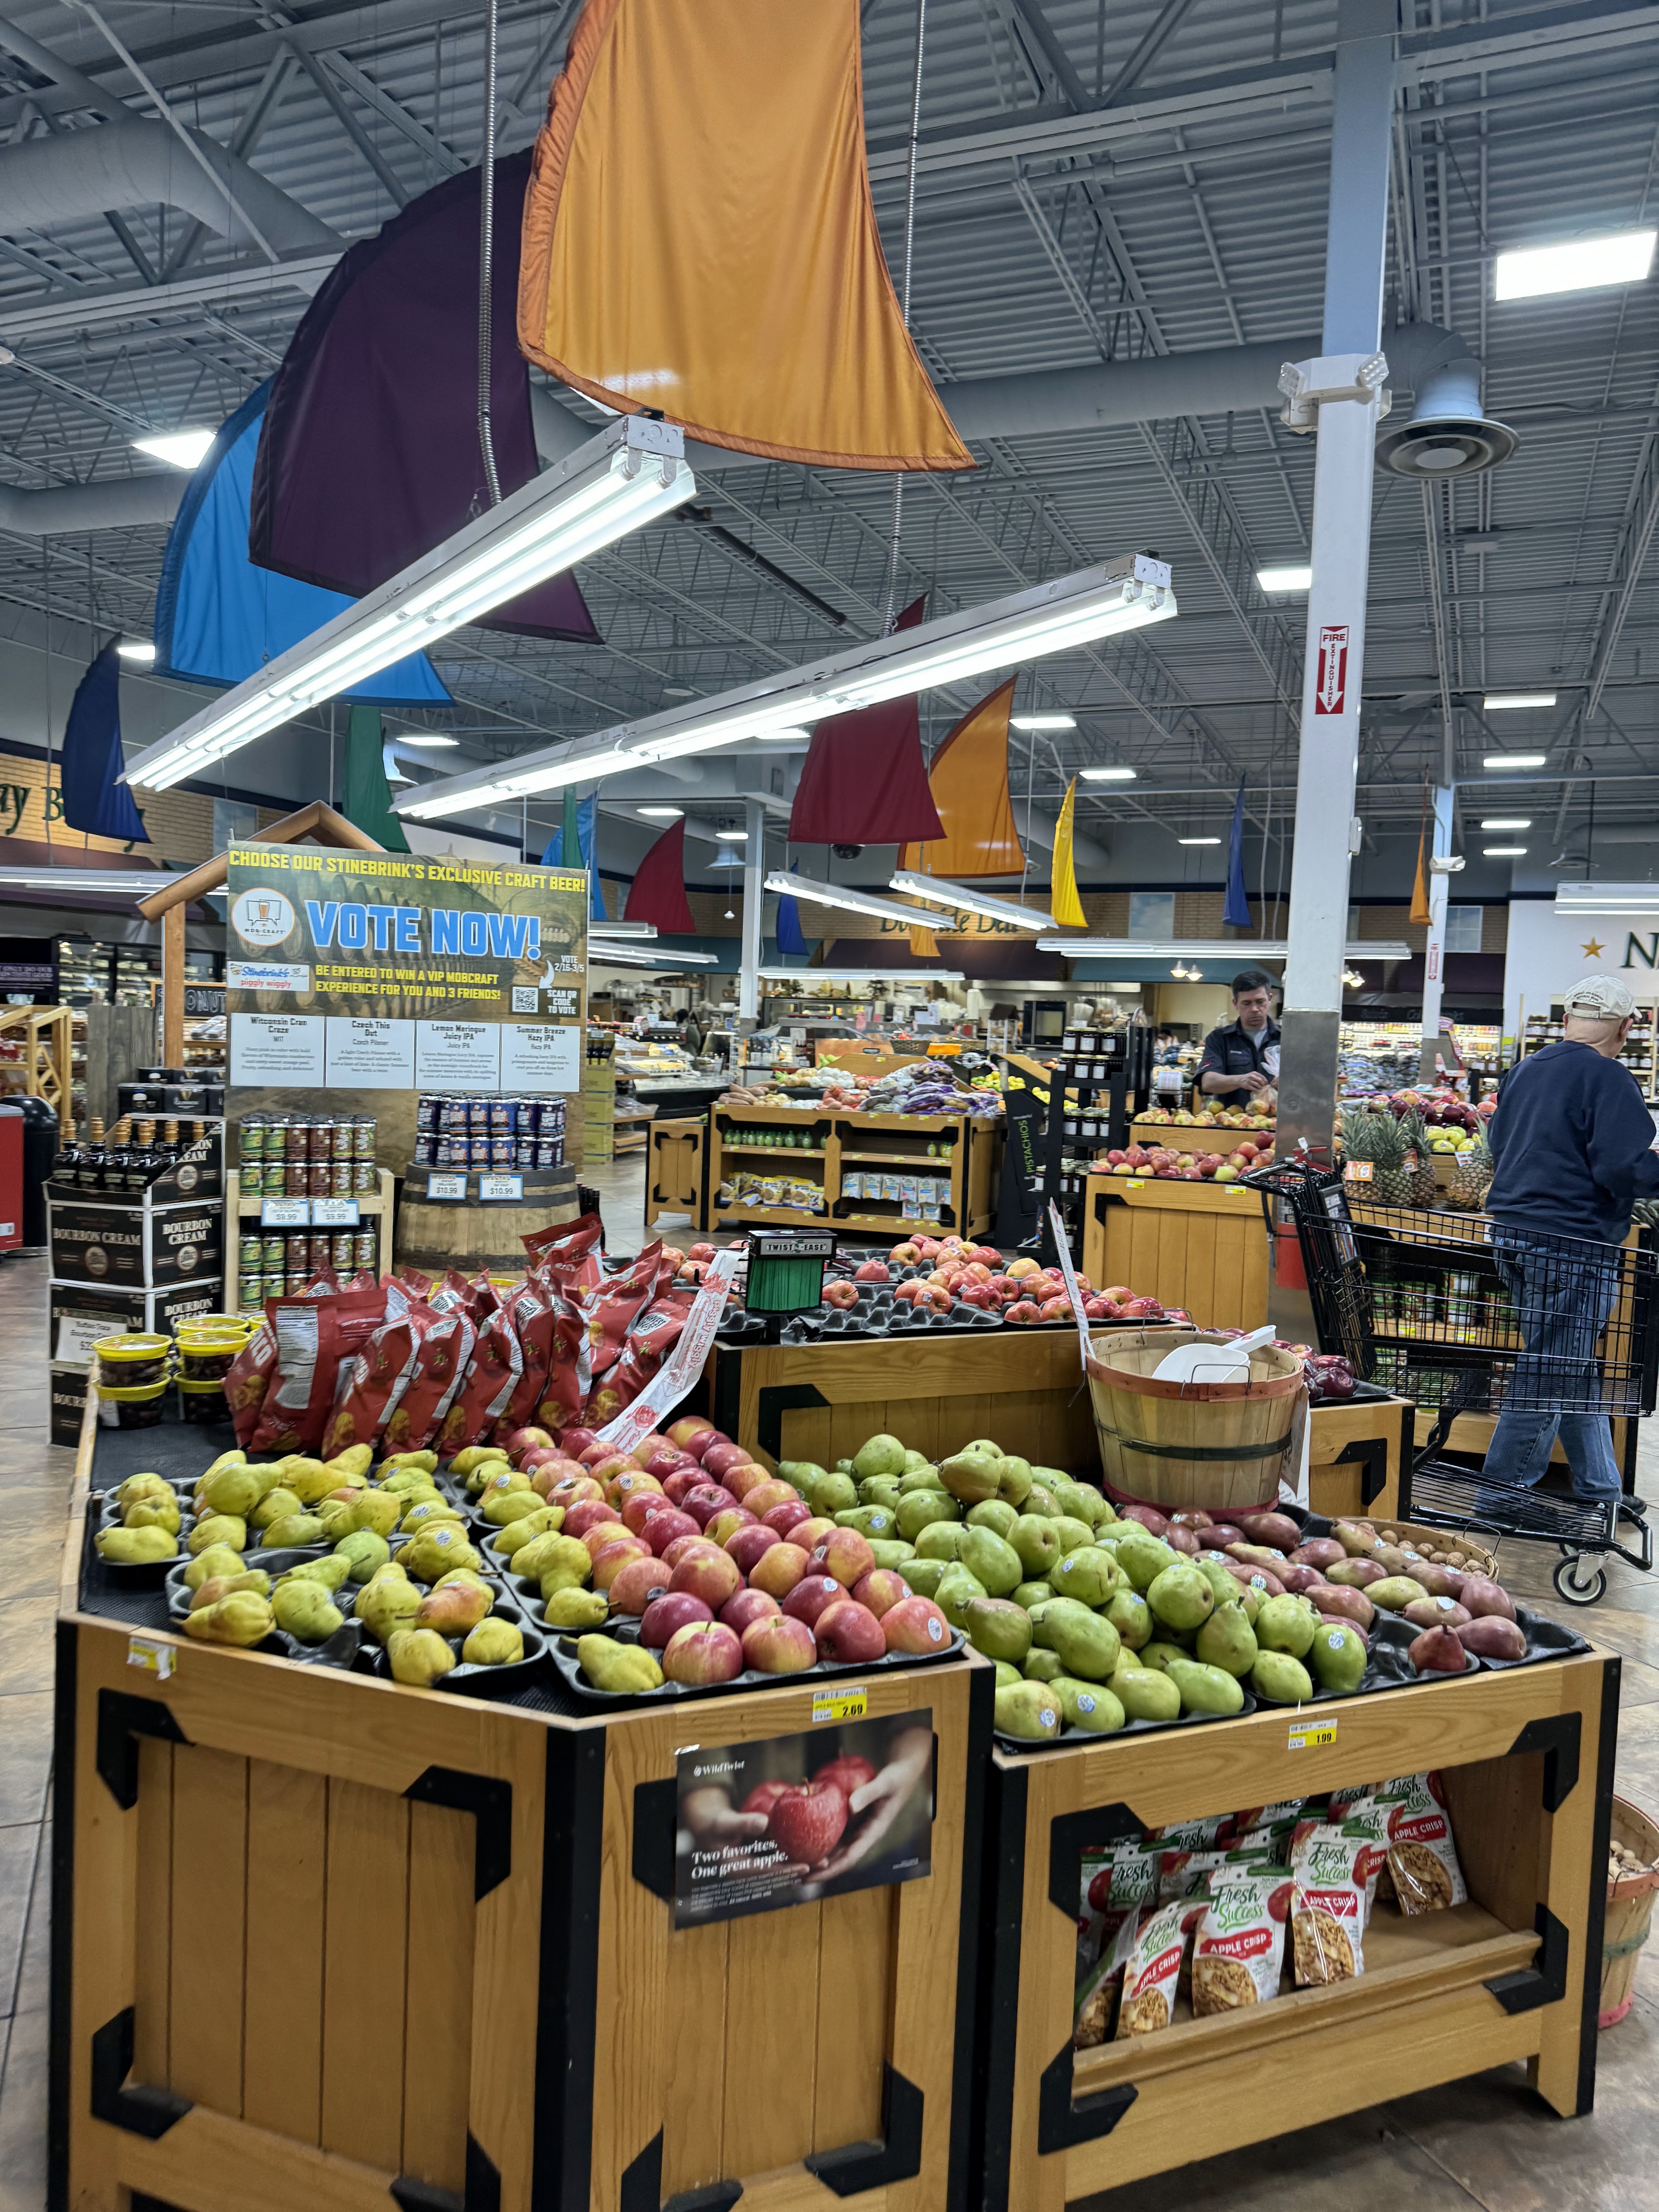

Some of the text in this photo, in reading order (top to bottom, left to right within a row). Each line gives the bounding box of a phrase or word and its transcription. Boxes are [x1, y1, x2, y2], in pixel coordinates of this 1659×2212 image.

[1327, 643, 1336, 707] EXTINGUISHER
[230, 851, 585, 892] CHOOSE OUR STINEBRINK'S EXCLUSIVE CRAFT BEER!
[304, 900, 541, 960] VOTE NOW!
[554, 963, 584, 973] 2/16-3/5
[561, 955, 578, 963] VOTE
[240, 979, 292, 989] piggly wiggly
[316, 965, 499, 984] BE ENTERED TO WIN A VIP MOBCRAFT
[315, 981, 501, 1000] EXPERIENCE FOR YOU AND 3 FRIENDS!
[547, 989, 566, 998] SCAN
[553, 998, 572, 1006] CODE
[558, 1006, 576, 1014] VOTE
[443, 1032, 462, 1041] Juicy
[1018, 1120, 1035, 1173] PISTACHIOS
[162, 1219, 212, 1235] BOURBON
[53, 1228, 141, 1246] BOURBON CREAM
[168, 1230, 207, 1245] CREAM
[164, 1298, 213, 1316] BOURBON
[1395, 1826, 1419, 1840] APPLE
[1420, 1820, 1443, 1833] CRISP
[692, 1840, 778, 1865] Two favorites.
[1308, 1841, 1350, 1866] Fresh
[692, 1850, 788, 1879] One great apple.
[1310, 1858, 1352, 1882] Success
[1211, 1883, 1262, 1913] Fresh
[1217, 1902, 1264, 1929] Success
[1210, 1933, 1267, 1954] APPLE CRISP
[1140, 1951, 1180, 1992] APPLE CRISP
